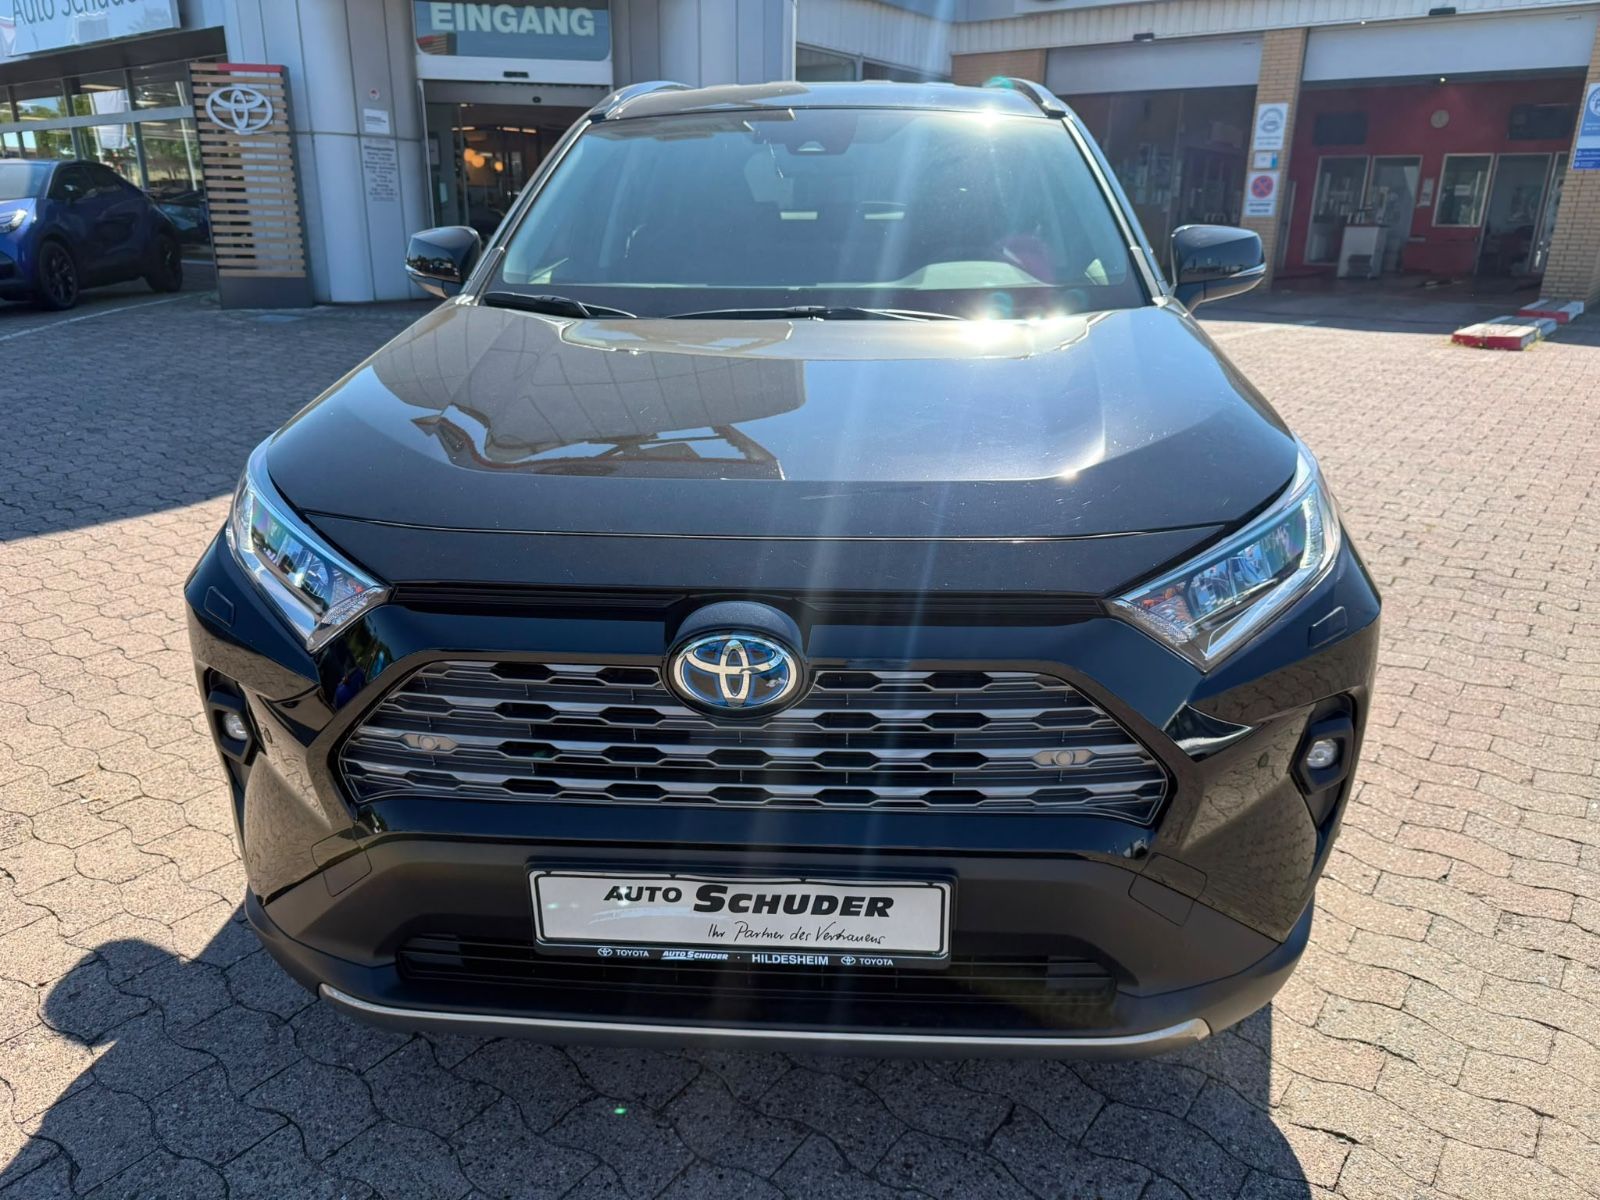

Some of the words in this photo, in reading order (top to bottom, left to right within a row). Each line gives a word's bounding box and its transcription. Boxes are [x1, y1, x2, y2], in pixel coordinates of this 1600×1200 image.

[430, 2, 595, 36] EINGANG
[603, 885, 683, 903] AUTO
[693, 885, 894, 917] SCHUDER
[708, 923, 726, 937] Ihr
[734, 920, 784, 942] Partner
[789, 926, 811, 941] des
[815, 921, 886, 944] Vertrauens
[615, 949, 649, 957] TOYOTA
[662, 950, 687, 958] AUTO
[687, 951, 729, 960] SCHUDER
[751, 953, 829, 965] HILDESHEIM
[859, 957, 894, 966] TOYOTA
